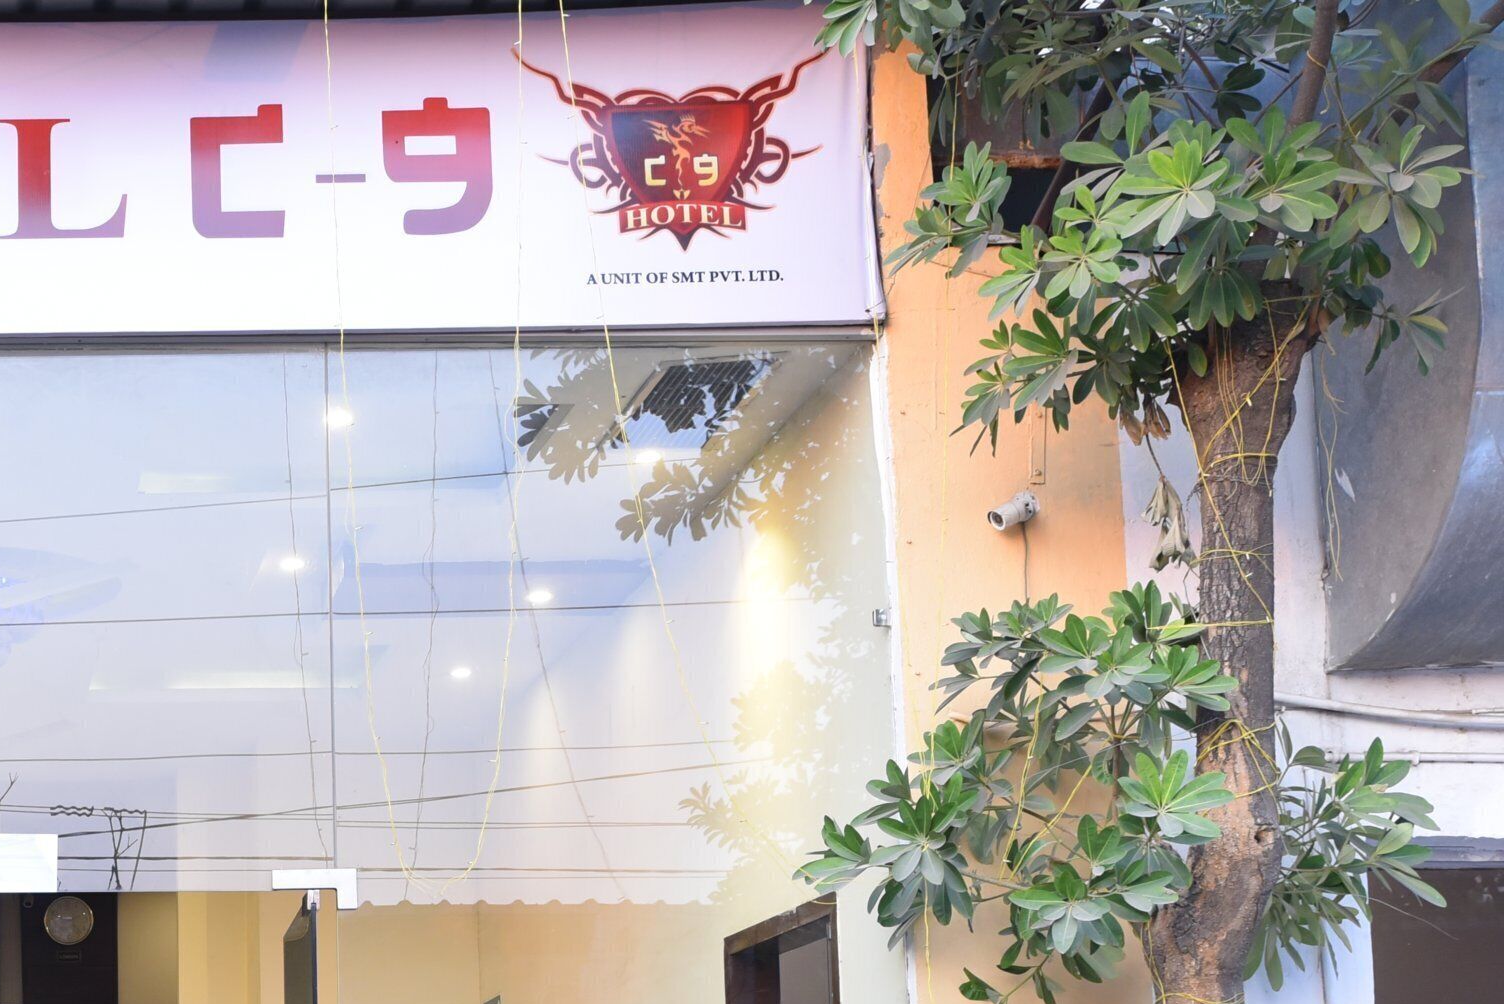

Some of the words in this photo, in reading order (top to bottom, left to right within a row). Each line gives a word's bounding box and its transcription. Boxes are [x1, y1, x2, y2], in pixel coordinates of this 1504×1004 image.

[189, 96, 494, 240] C-9
[625, 203, 743, 231] HOTEL
[587, 273, 597, 285] A
[601, 272, 642, 285] UNIT
[646, 271, 668, 284] OF
[671, 271, 706, 284] SMT
[709, 270, 745, 283] PVT.
[748, 269, 784, 282] LTD.
